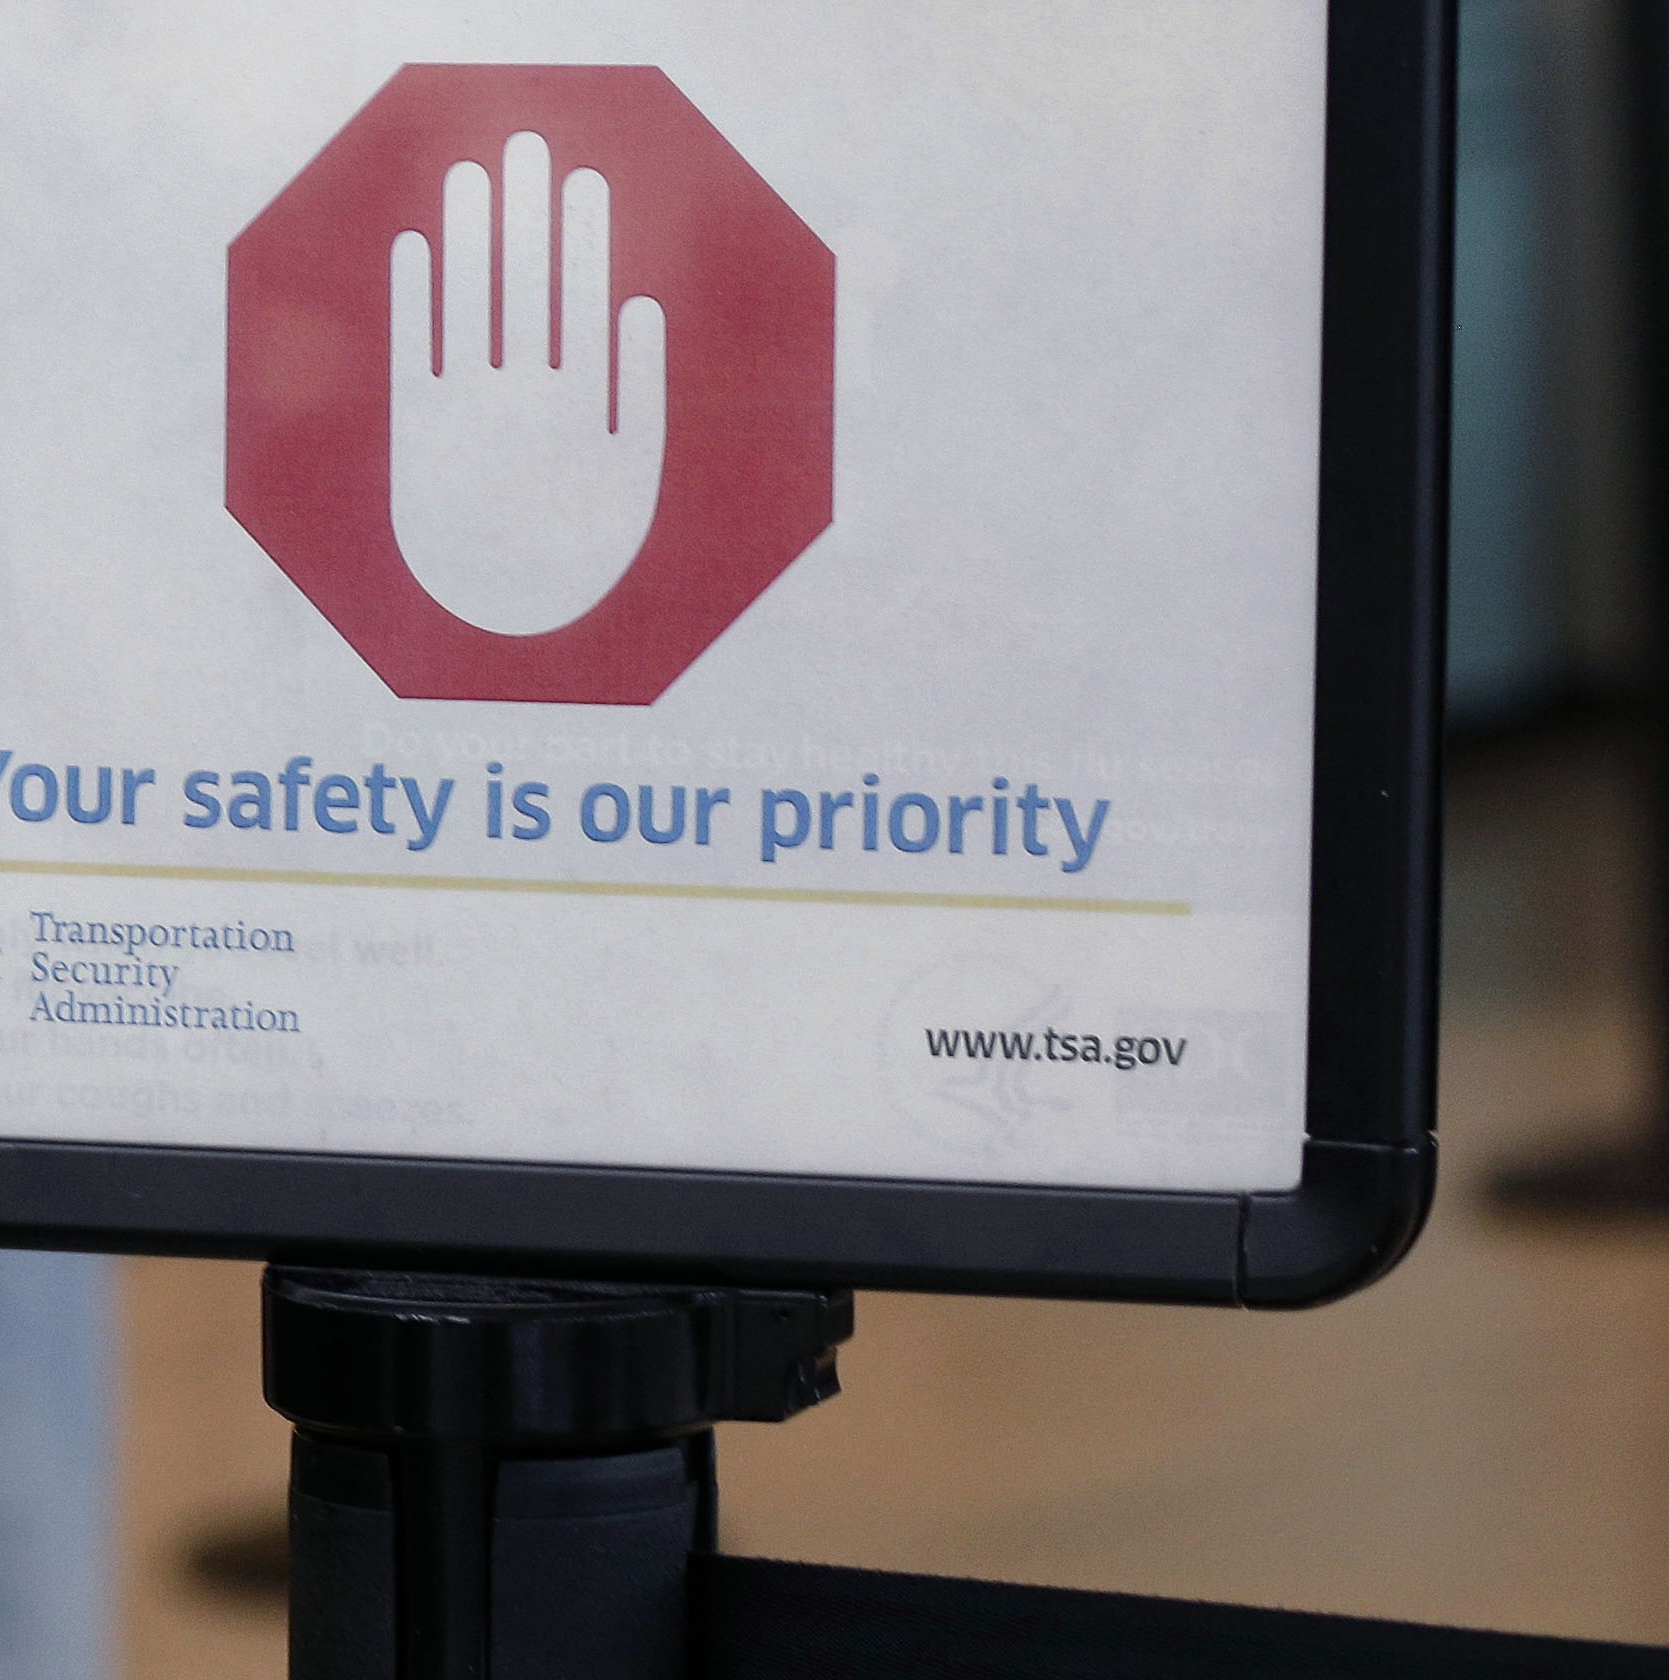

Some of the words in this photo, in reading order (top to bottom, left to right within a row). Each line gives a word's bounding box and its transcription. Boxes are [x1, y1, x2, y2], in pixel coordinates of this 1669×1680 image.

[183, 756, 455, 852] safety
[486, 762, 551, 841] is
[580, 783, 731, 846] our
[760, 773, 1110, 874] priority
[30, 911, 295, 959] Transportation
[30, 950, 179, 999] Security
[28, 990, 301, 1033] Administration
[925, 1027, 1188, 1072] www.tsa.gov
